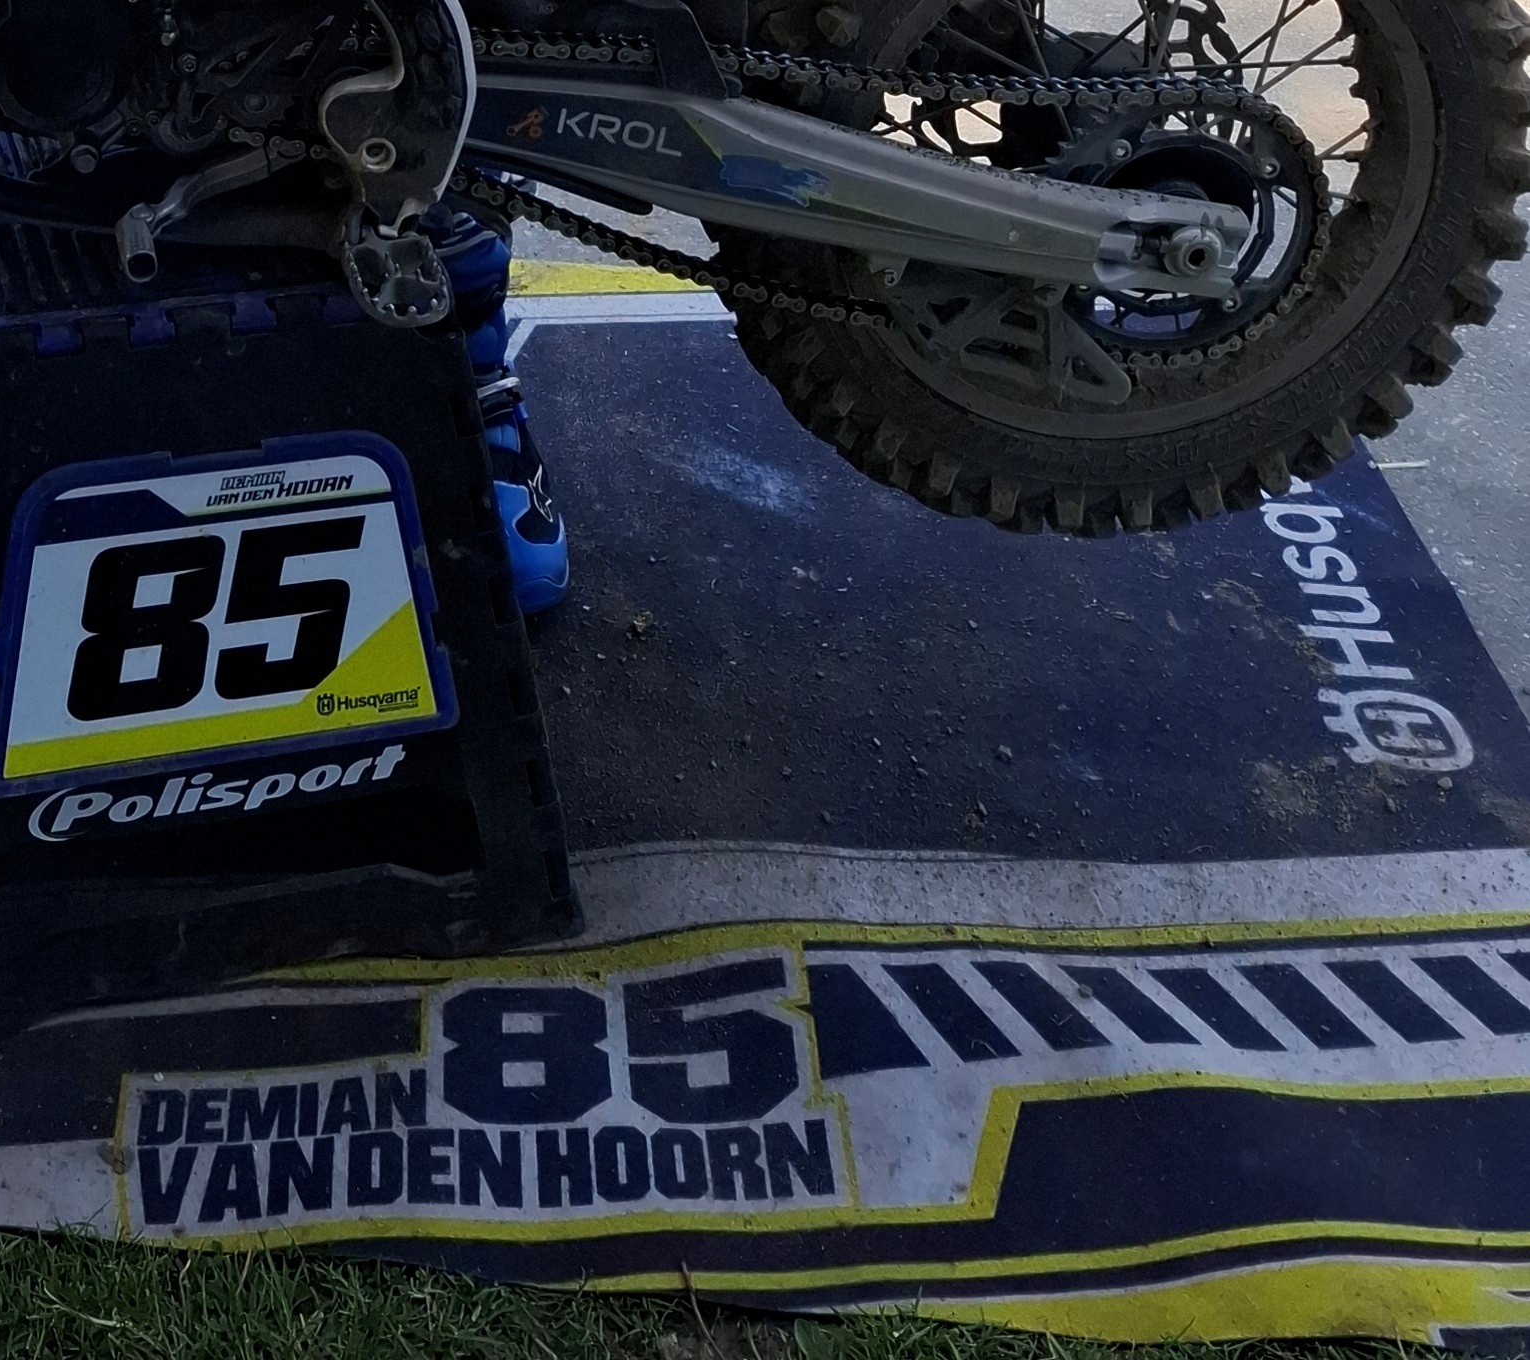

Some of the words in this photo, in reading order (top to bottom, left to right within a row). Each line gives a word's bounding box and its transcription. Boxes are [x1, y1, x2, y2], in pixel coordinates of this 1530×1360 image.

[557, 108, 683, 158] KROL
[206, 491, 240, 507] VAN
[241, 488, 274, 503] DEN
[276, 474, 354, 498] HOORN
[220, 470, 286, 491] DEMIAN
[66, 515, 366, 721] 85
[337, 687, 419, 711] Husqvarna
[30, 744, 406, 842] Polisport
[443, 956, 799, 1126] 85
[138, 1069, 428, 1147] DEMIAN
[138, 1134, 338, 1226] VAN
[347, 1126, 523, 1209] DEN
[535, 1118, 836, 1209] HOORN
